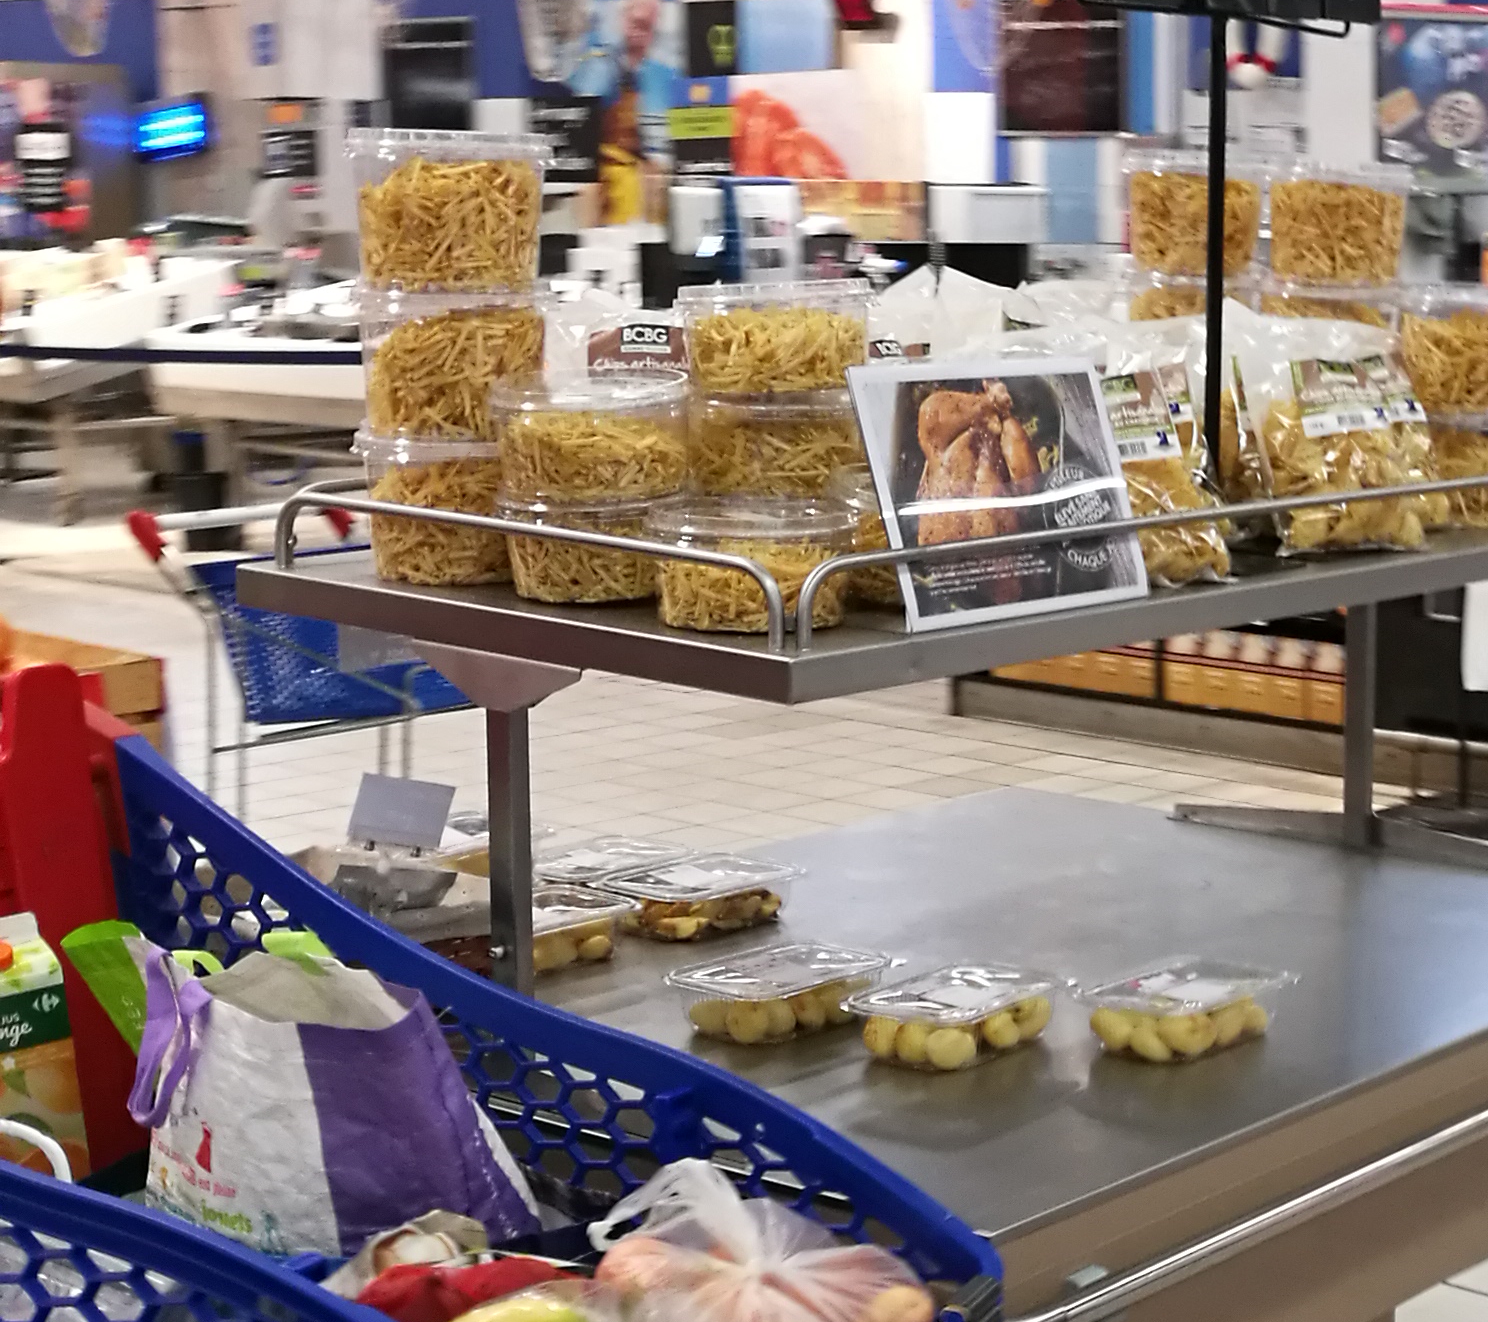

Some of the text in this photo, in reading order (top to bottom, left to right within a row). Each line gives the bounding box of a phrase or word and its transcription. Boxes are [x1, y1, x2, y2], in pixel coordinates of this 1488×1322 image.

[622, 327, 669, 344] BCBG
[1, 1012, 20, 1024] JUS
[0, 1021, 33, 1047] nge
